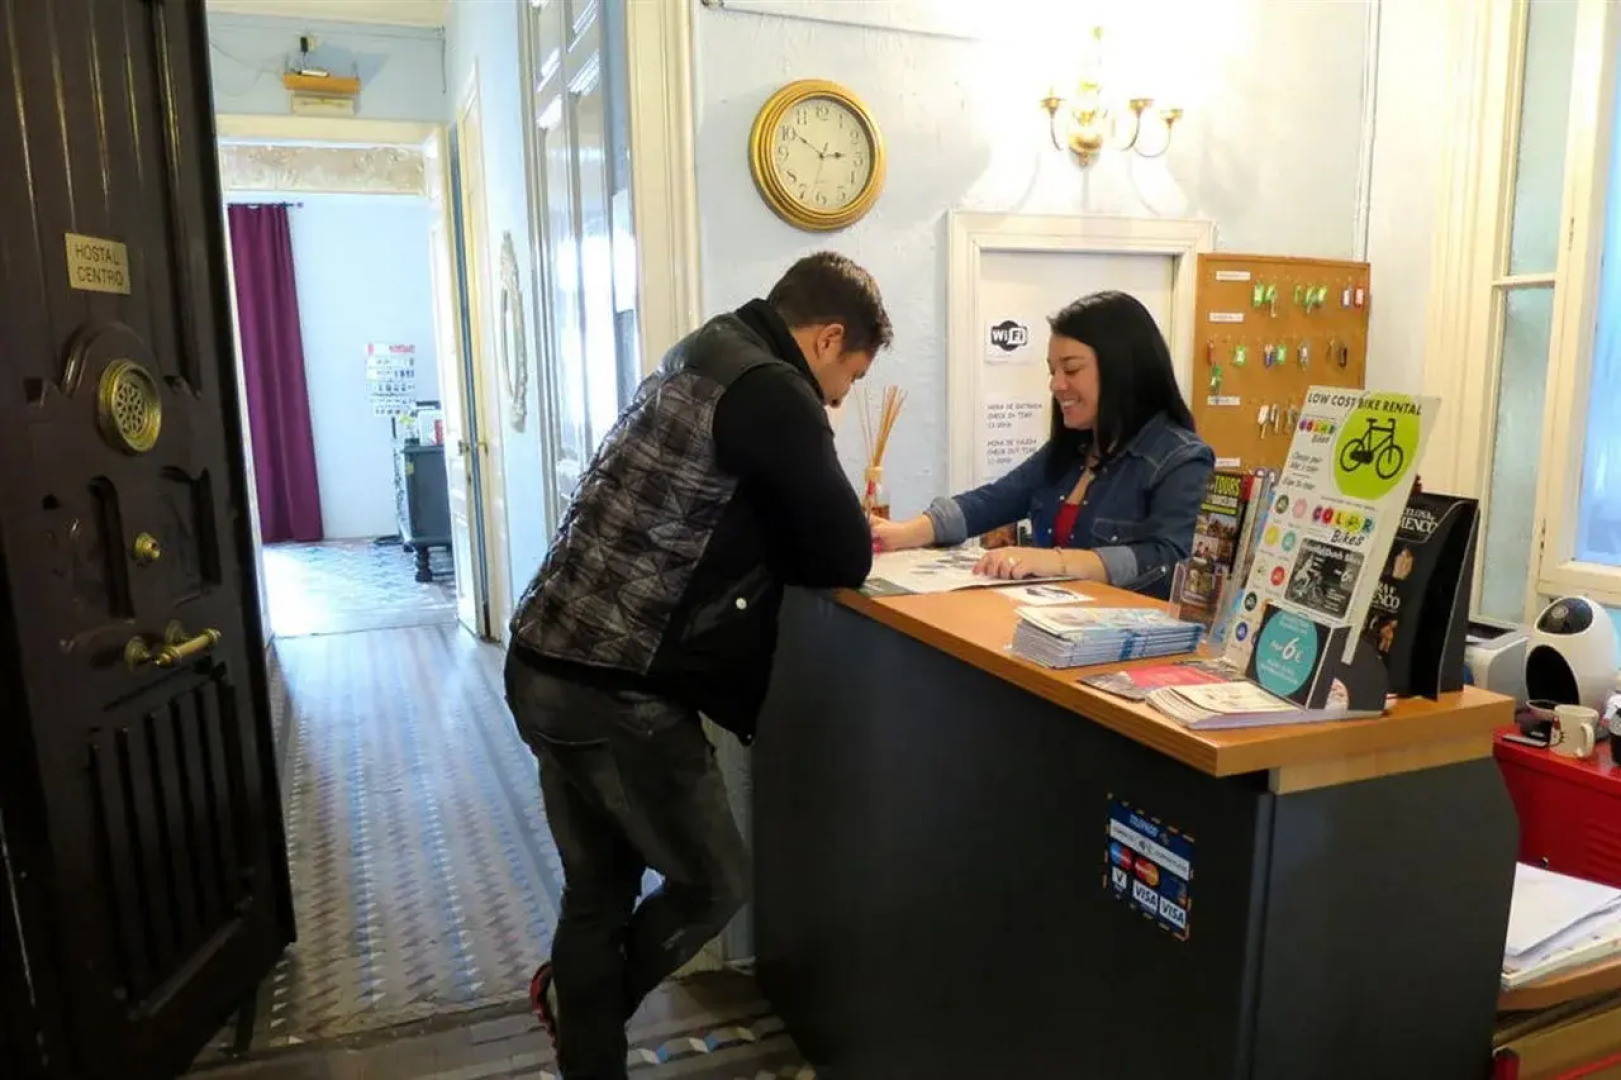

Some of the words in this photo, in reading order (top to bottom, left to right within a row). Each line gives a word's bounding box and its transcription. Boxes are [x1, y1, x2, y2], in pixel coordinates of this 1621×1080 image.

[782, 126, 795, 141] 10
[75, 243, 121, 266] HOSTAL
[76, 265, 124, 287] CENTRO
[1307, 392, 1331, 405] LOW
[1331, 394, 1356, 407] COST
[1357, 397, 1380, 411] BIKE
[1382, 400, 1422, 416] RENTAL
[1215, 475, 1241, 497] TOURS
[1312, 505, 1374, 535] COLOR
[1331, 529, 1365, 547] Bikes
[1134, 884, 1157, 906] VISA
[1162, 901, 1185, 924] VISA
